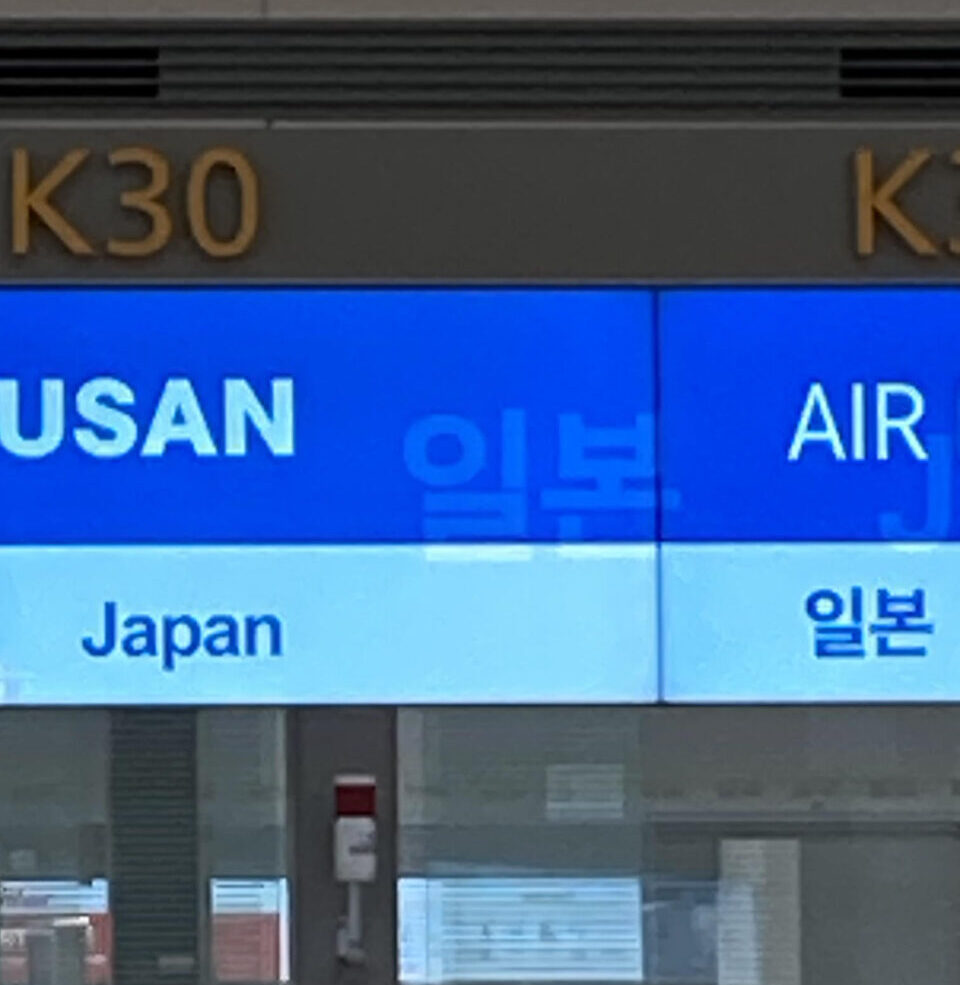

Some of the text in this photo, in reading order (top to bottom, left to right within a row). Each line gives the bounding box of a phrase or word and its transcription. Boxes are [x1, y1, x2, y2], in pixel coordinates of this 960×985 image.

[8, 147, 261, 258] K30
[856, 147, 960, 256] K
[787, 382, 929, 461] AIR
[81, 601, 284, 671] Japan
[805, 586, 934, 659] 일본
